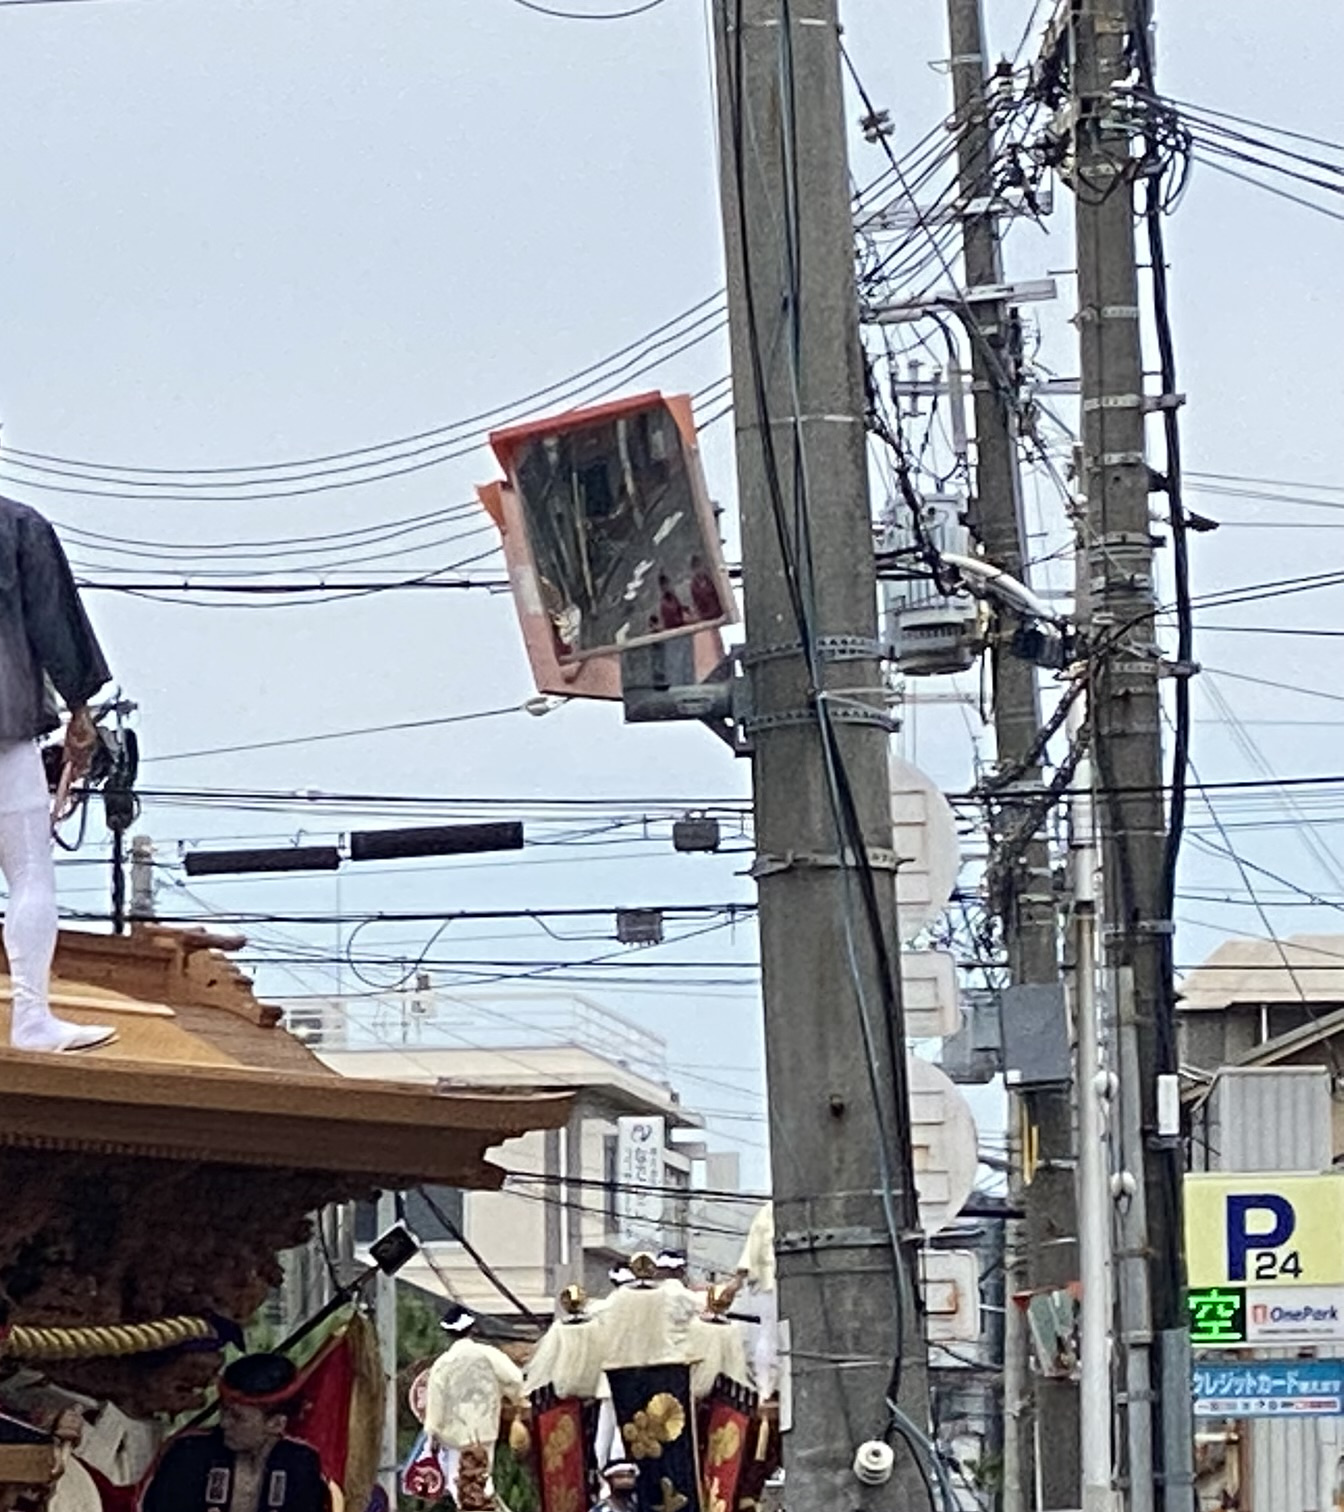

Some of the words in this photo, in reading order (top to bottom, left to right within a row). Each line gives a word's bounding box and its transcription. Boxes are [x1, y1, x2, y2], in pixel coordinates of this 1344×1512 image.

[1226, 1193, 1296, 1282] P
[1255, 1251, 1303, 1280] 24
[1187, 1288, 1242, 1340] 空
[1270, 1305, 1338, 1322] OnePark
